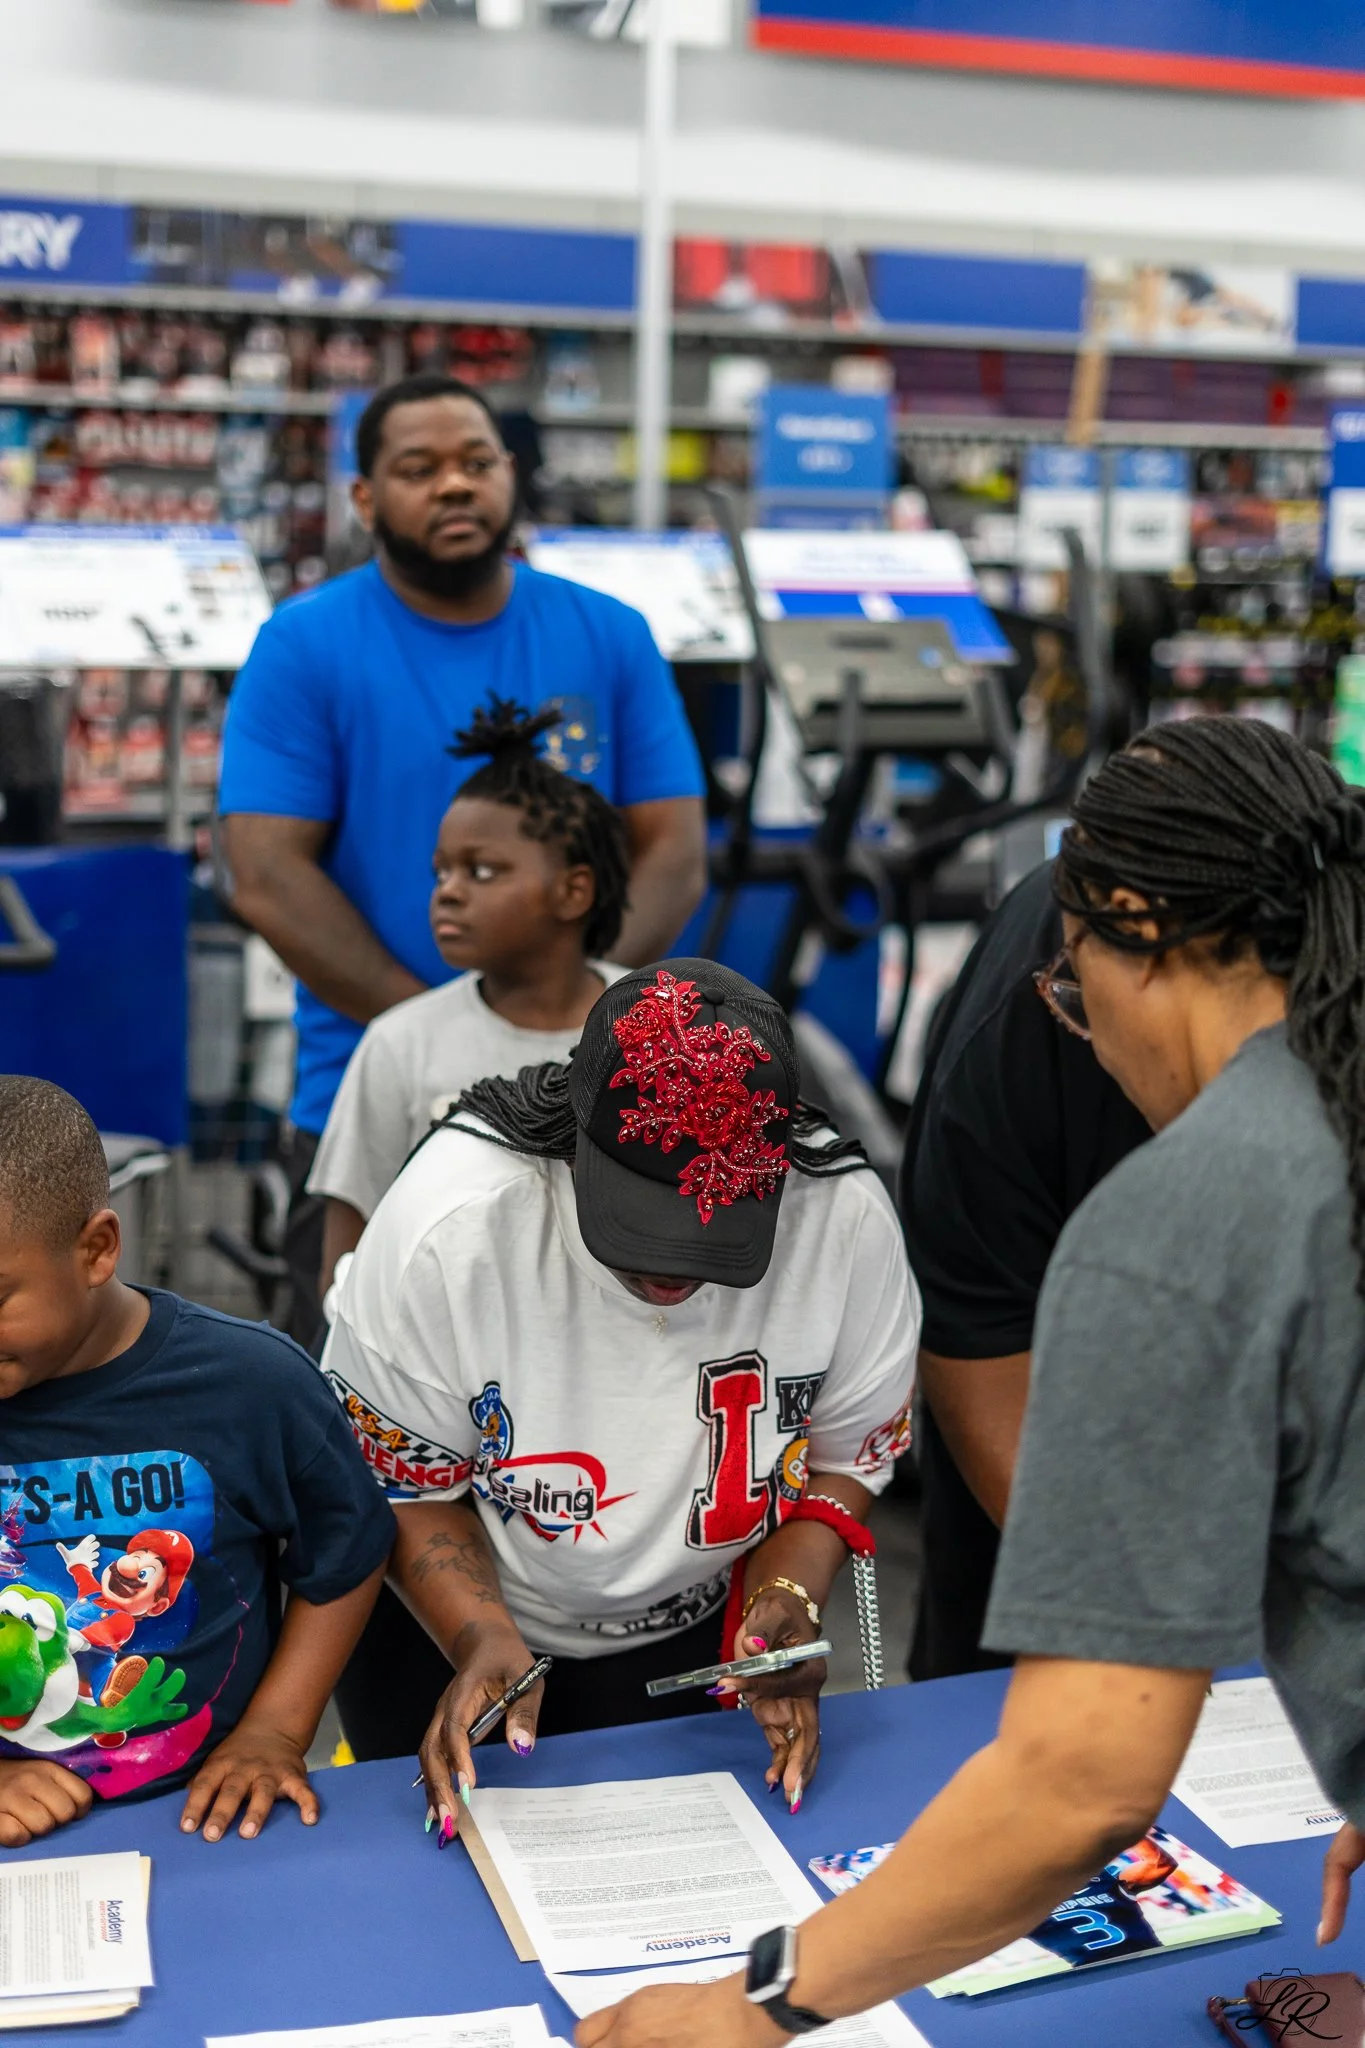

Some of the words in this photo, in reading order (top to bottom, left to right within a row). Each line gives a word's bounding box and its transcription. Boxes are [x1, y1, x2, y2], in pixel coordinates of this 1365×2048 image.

[352, 1427, 472, 1488] LENGE
[111, 1461, 185, 1517] GO!
[105, 1900, 125, 1943] Academy
[1051, 1909, 1126, 1951] 3
[644, 1935, 731, 1952] Academy
